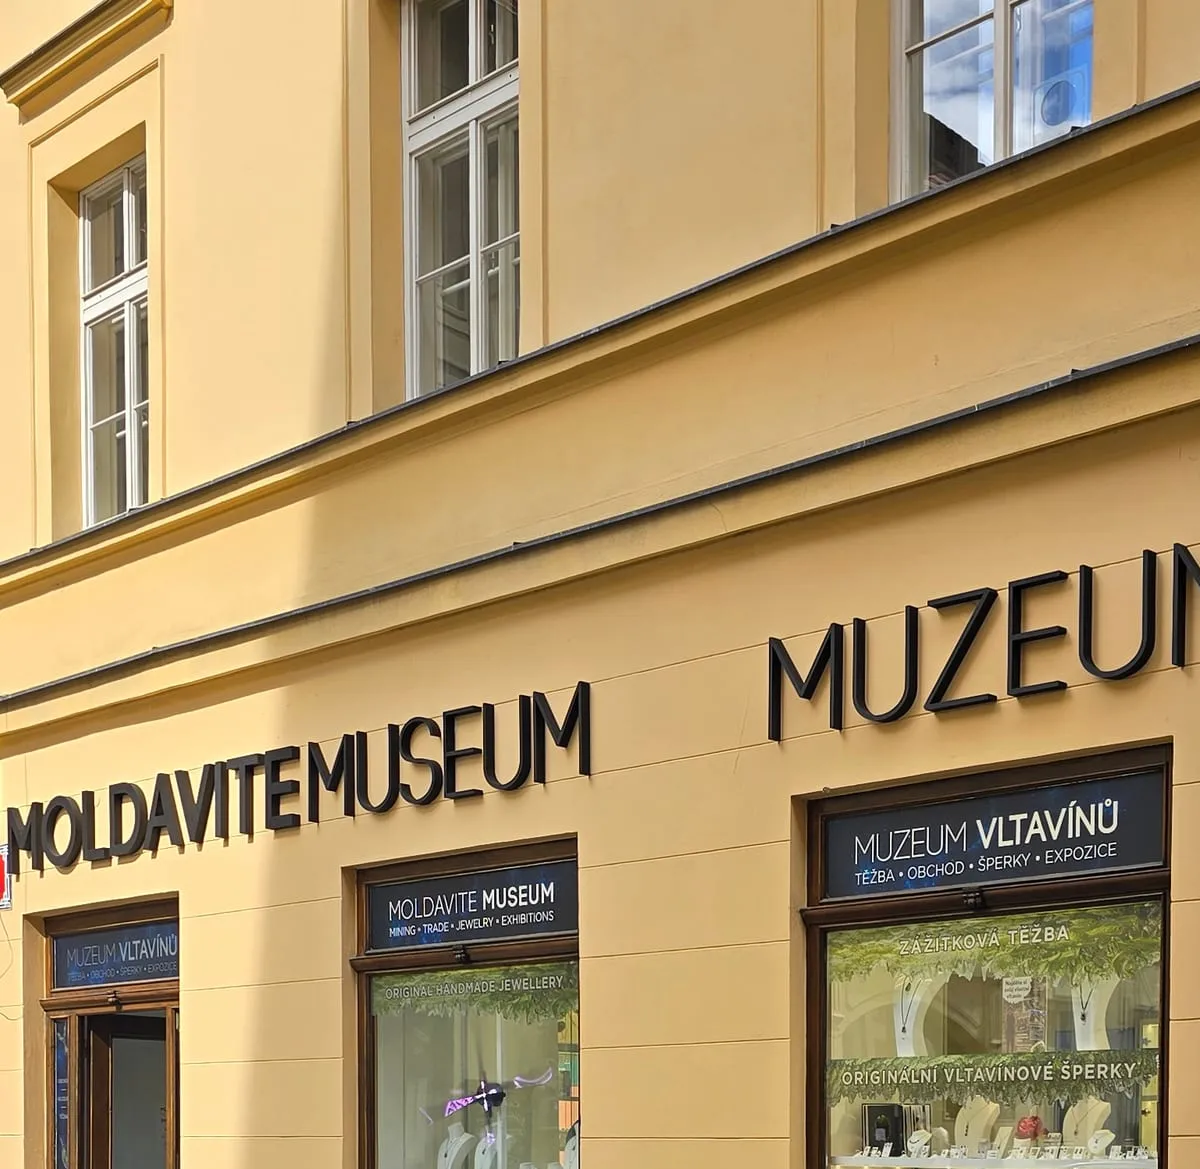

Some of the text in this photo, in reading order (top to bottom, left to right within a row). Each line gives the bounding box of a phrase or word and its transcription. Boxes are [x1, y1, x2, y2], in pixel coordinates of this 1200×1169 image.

[7, 681, 591, 876] MOLDAVITE MUSEUM
[854, 798, 1119, 865] MUZEUM VLTAVÍNŮ
[854, 842, 1117, 886] TĚŽBA OBCHOD ŠPERKY EXPOZICE
[388, 881, 554, 921] MOLDAVITE MUSEUM
[389, 910, 554, 938] MINING TRADE JEWELRY EXHIBITIONS
[899, 924, 1070, 956] ZÁŽITKOVÁ TĚŽBA
[67, 933, 178, 968] MUZEUM VLTAVÍNŮ
[386, 975, 564, 1000] ORIGINAL HANDMADE JEWELLERY
[841, 1059, 1137, 1086] ORIGINÁLNÍ VLTAVÍNOVÉ ŠPERKY
